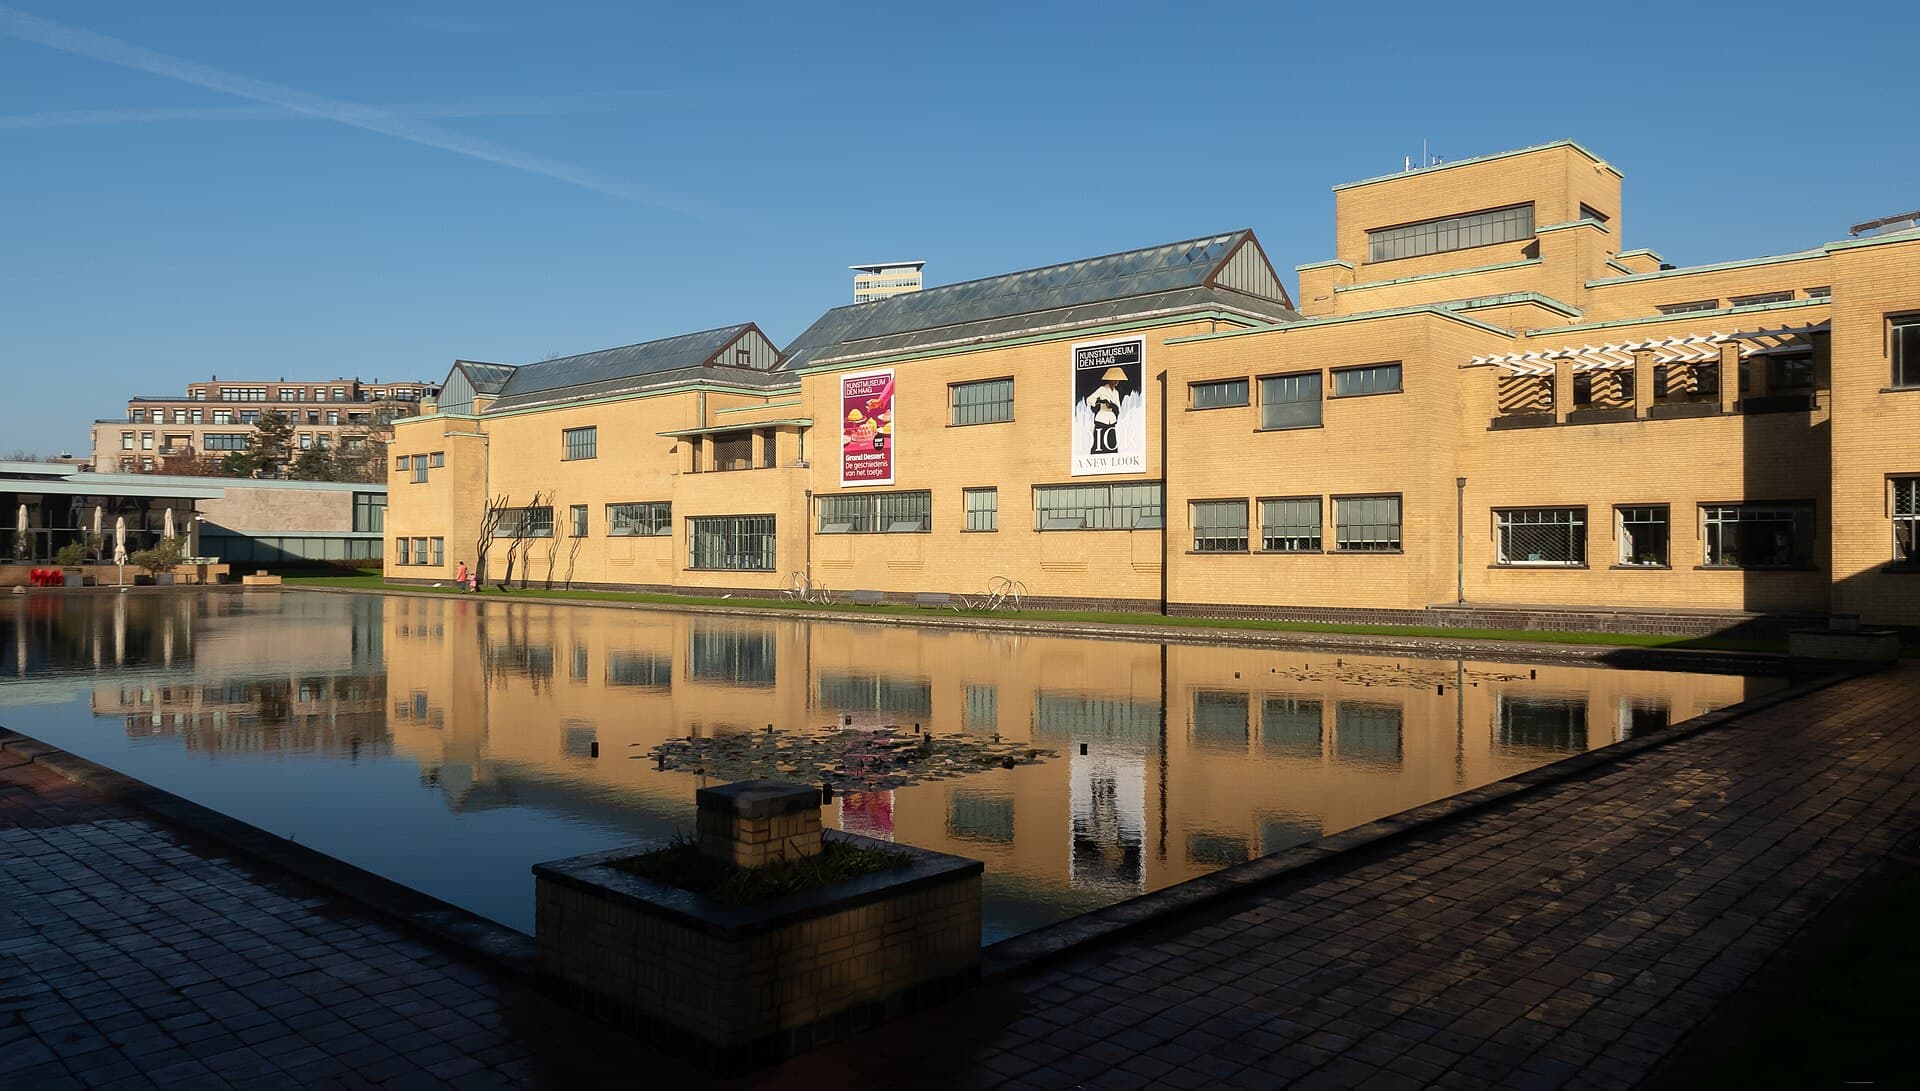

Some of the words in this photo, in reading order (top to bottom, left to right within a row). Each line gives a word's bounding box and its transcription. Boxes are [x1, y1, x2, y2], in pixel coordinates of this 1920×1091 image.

[1080, 346, 1134, 359] KUNSTMUSEUM
[1080, 359, 1095, 367] DEN
[1095, 356, 1115, 366] HAAG
[847, 379, 886, 389] KUNSTMUSEUM
[847, 388, 858, 396] DEN
[858, 386, 873, 394] HAAG
[845, 453, 863, 461] Grand
[1086, 457, 1108, 468] NEW
[1111, 455, 1140, 467] LOOK
[853, 460, 888, 470] geschiedenis
[867, 468, 883, 476] toetje
